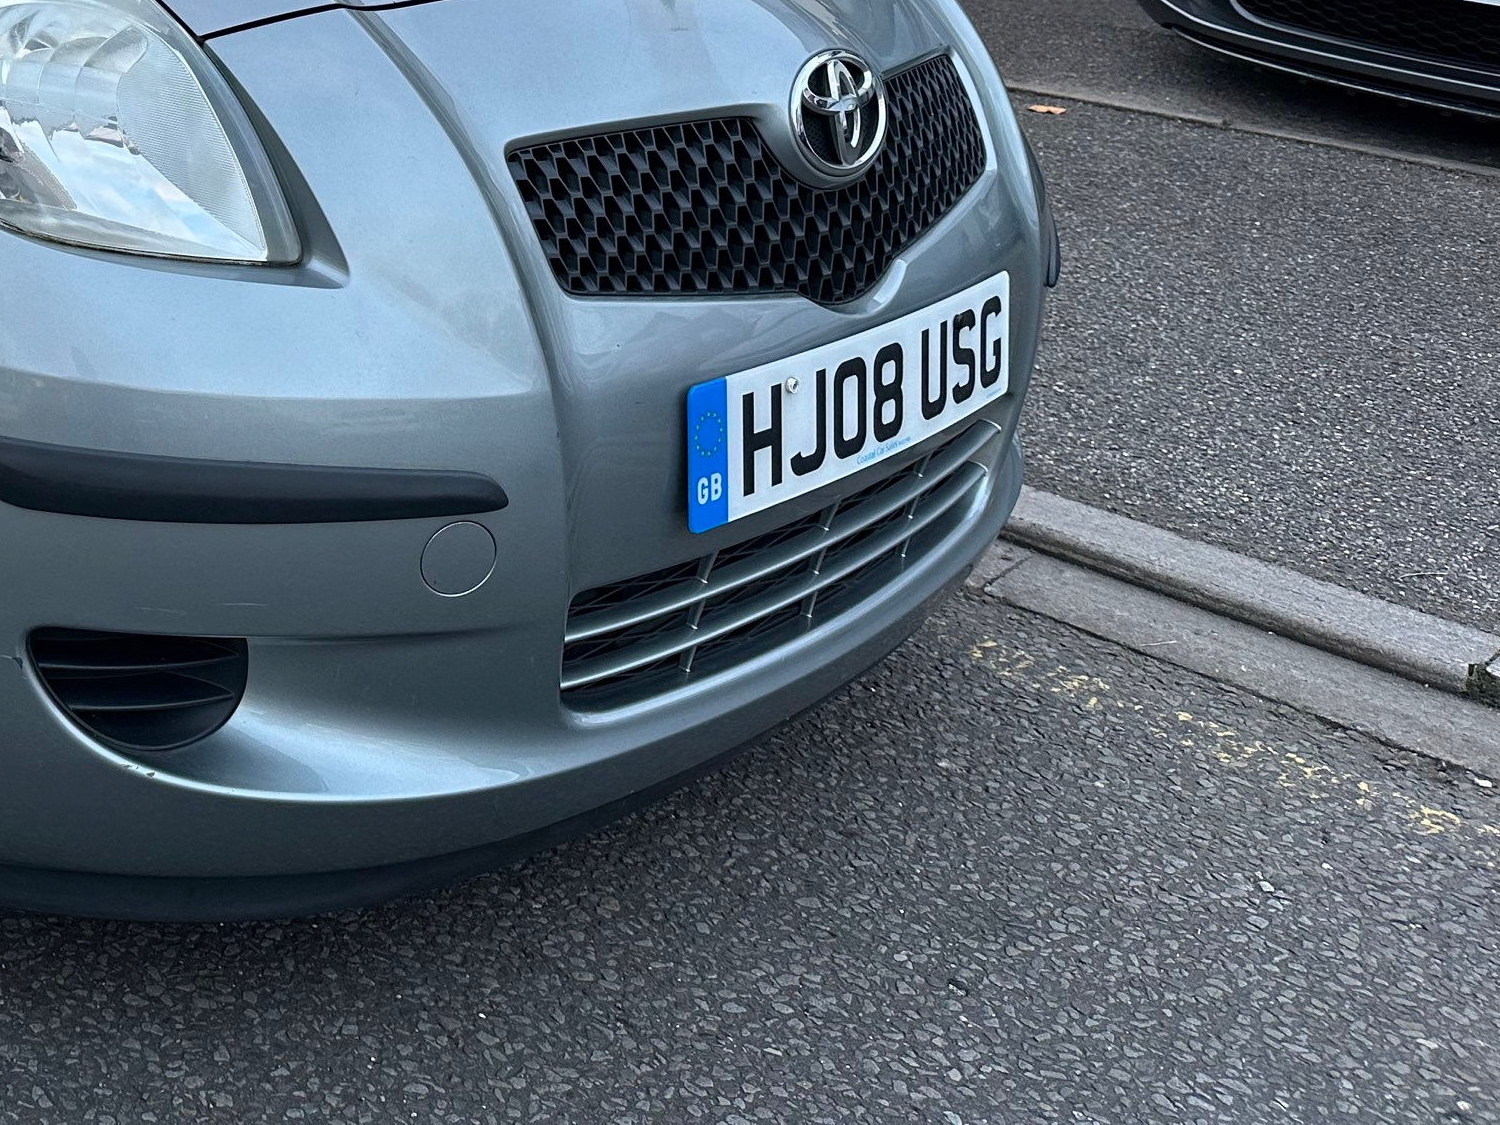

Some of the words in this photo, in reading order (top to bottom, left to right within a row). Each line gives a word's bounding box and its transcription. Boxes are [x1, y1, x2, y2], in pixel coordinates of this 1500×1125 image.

[742, 341, 904, 498] HJ08
[921, 295, 1002, 421] USG
[697, 472, 723, 506] GB
